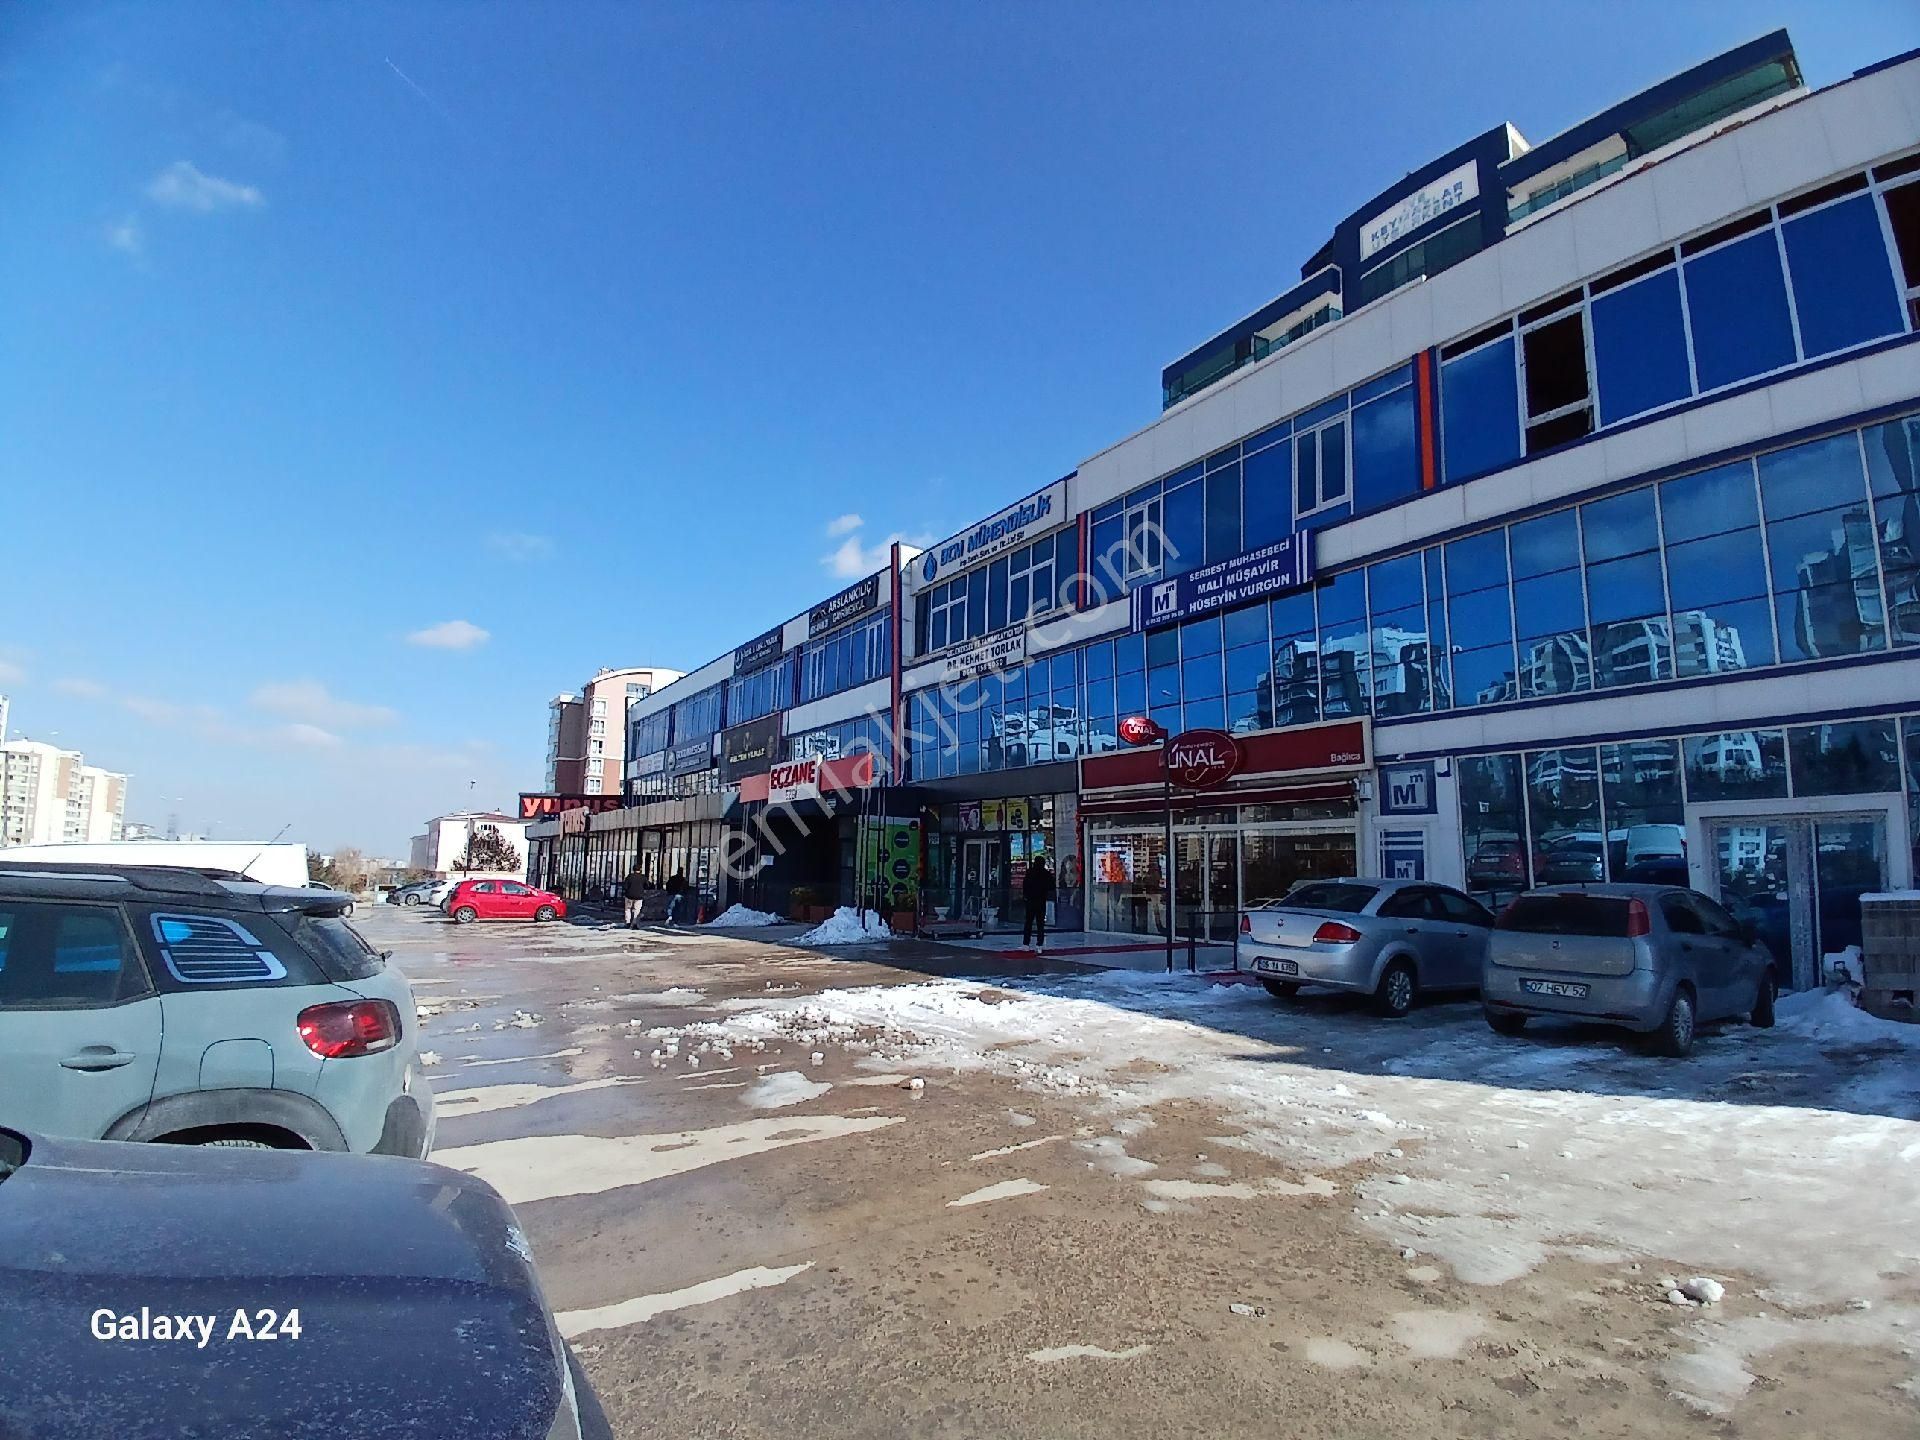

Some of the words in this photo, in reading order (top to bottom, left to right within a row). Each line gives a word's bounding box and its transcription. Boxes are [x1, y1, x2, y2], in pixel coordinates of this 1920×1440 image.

[967, 494, 1052, 553] MÜHENDİSLİK
[1189, 562, 1227, 582] SERBEST
[1229, 537, 1290, 569] MUHASEBECİ
[1189, 589, 1237, 613] HÜSEYİN
[1239, 573, 1290, 598] VURGUN
[1197, 575, 1223, 595] MALİ
[1226, 559, 1279, 586] MÜŞAVİR
[960, 648, 989, 666] MEHMET
[991, 638, 1022, 658] TORLAK
[1330, 753, 1361, 763] Bağlıca
[770, 760, 816, 790] ECZANE
[1530, 982, 1544, 992] 07
[1546, 984, 1569, 994] HEV
[1572, 986, 1586, 996] 52
